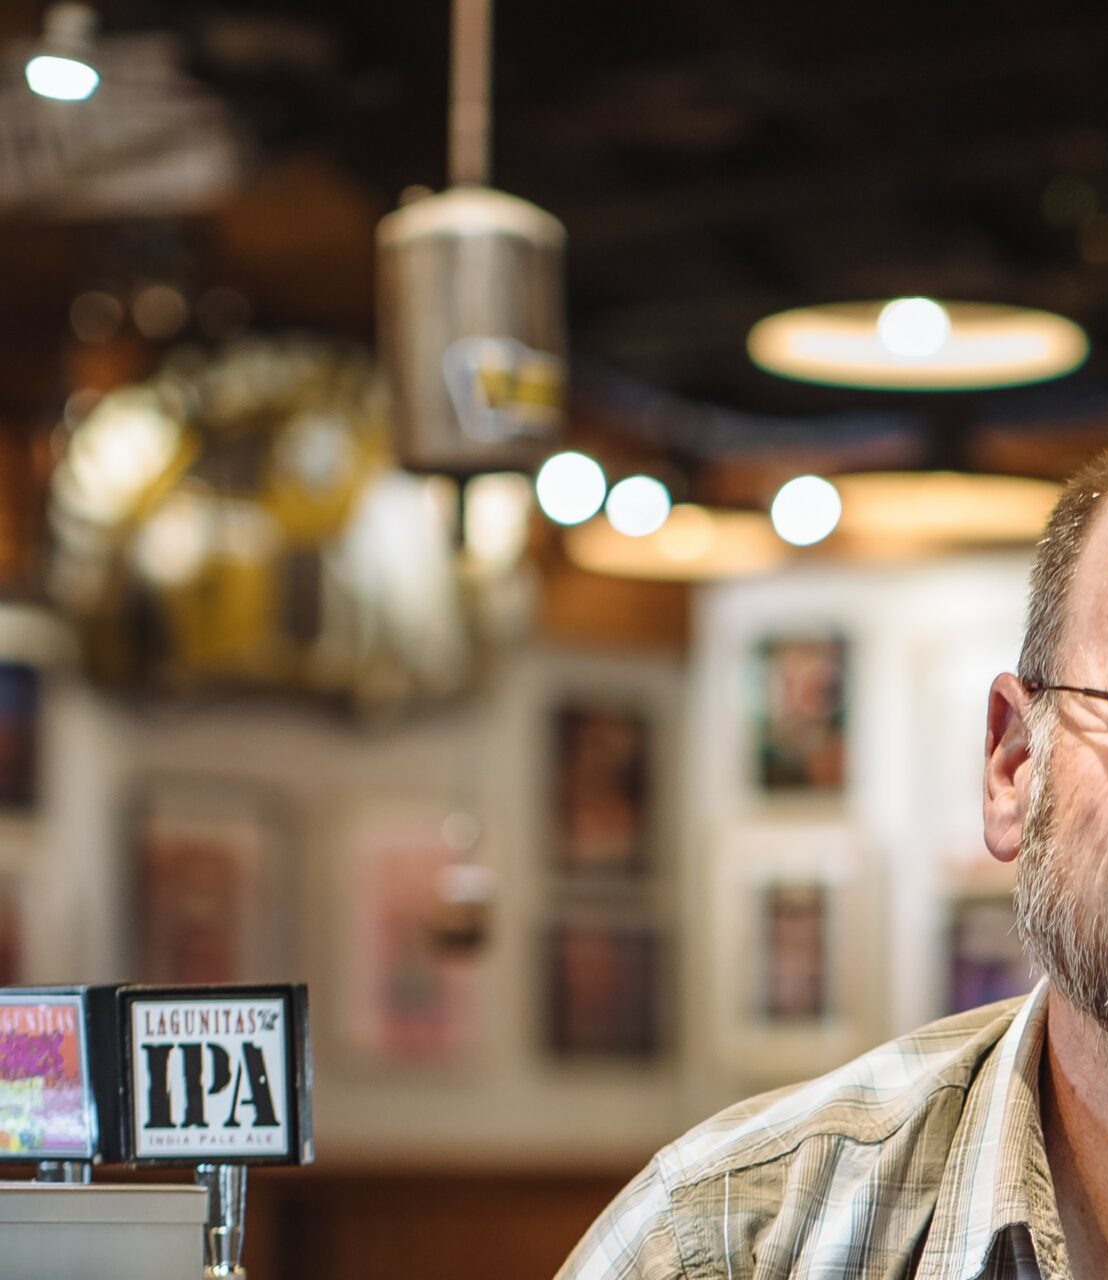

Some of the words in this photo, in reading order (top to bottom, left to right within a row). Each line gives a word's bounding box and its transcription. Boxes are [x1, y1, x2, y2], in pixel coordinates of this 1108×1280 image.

[144, 1007, 256, 1037] LAGUNITAS
[141, 1041, 281, 1129] IPA
[149, 1134, 190, 1146] INDIA
[199, 1133, 235, 1145] PALE
[245, 1132, 273, 1145] ALE
